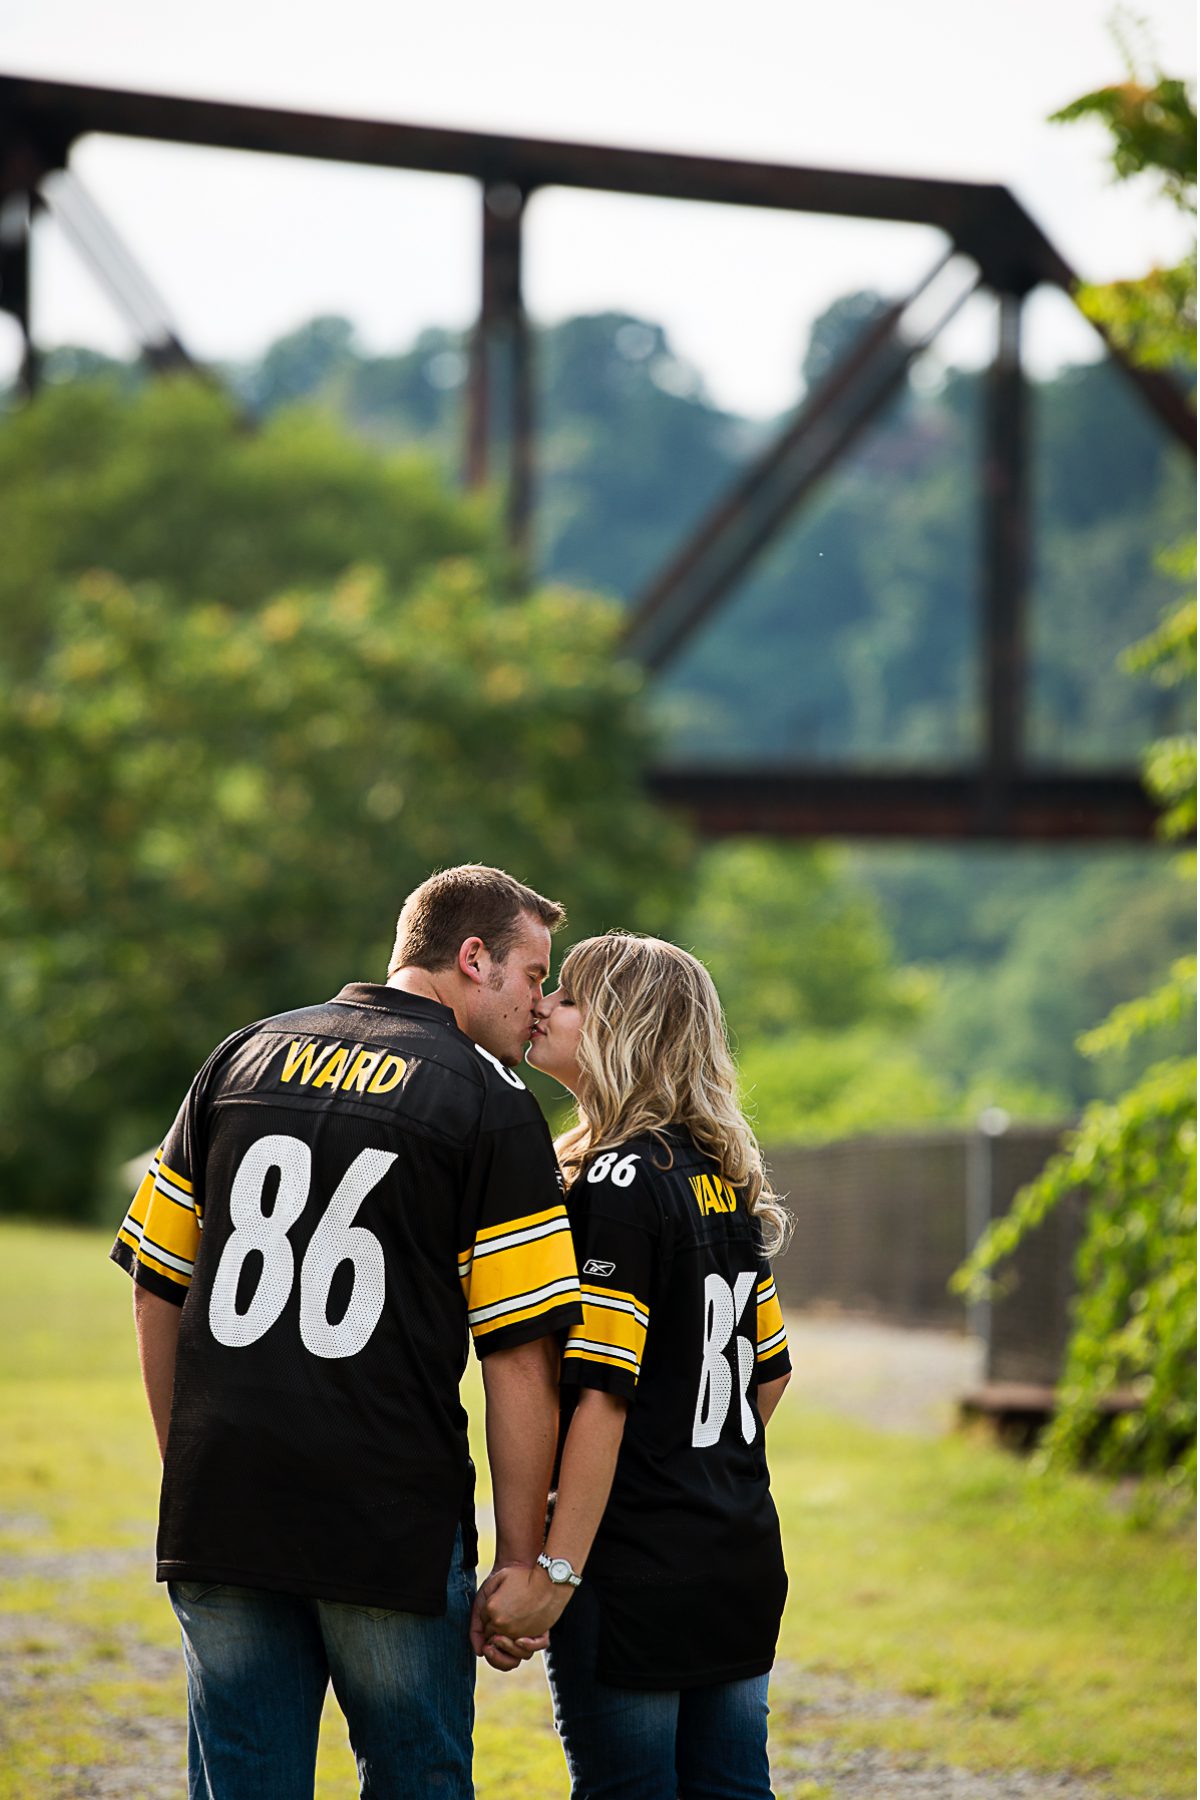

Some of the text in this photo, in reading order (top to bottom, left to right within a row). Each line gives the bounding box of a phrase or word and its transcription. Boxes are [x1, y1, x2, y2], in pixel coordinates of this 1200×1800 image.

[281, 1041, 408, 1094] WARD
[586, 1151, 643, 1188] 86
[208, 1134, 399, 1359] 86
